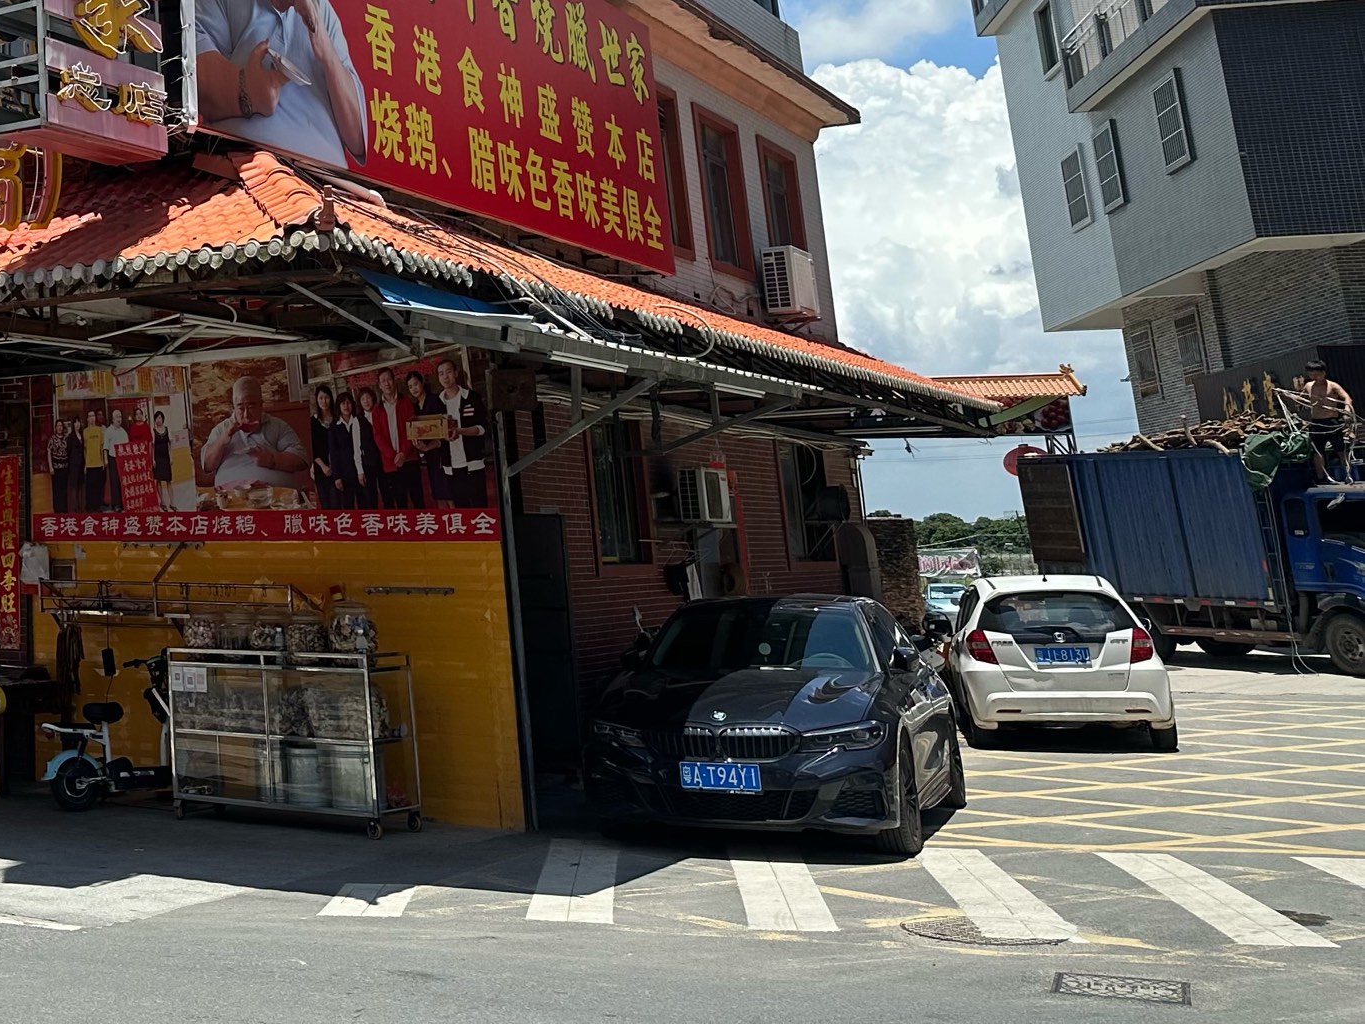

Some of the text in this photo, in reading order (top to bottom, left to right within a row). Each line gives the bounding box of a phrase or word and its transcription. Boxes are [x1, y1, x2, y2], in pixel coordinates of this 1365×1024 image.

[364, 3, 656, 184] 香港食神盛赞本店
[370, 88, 666, 252] 烧鹅、腊味色香味美俱全
